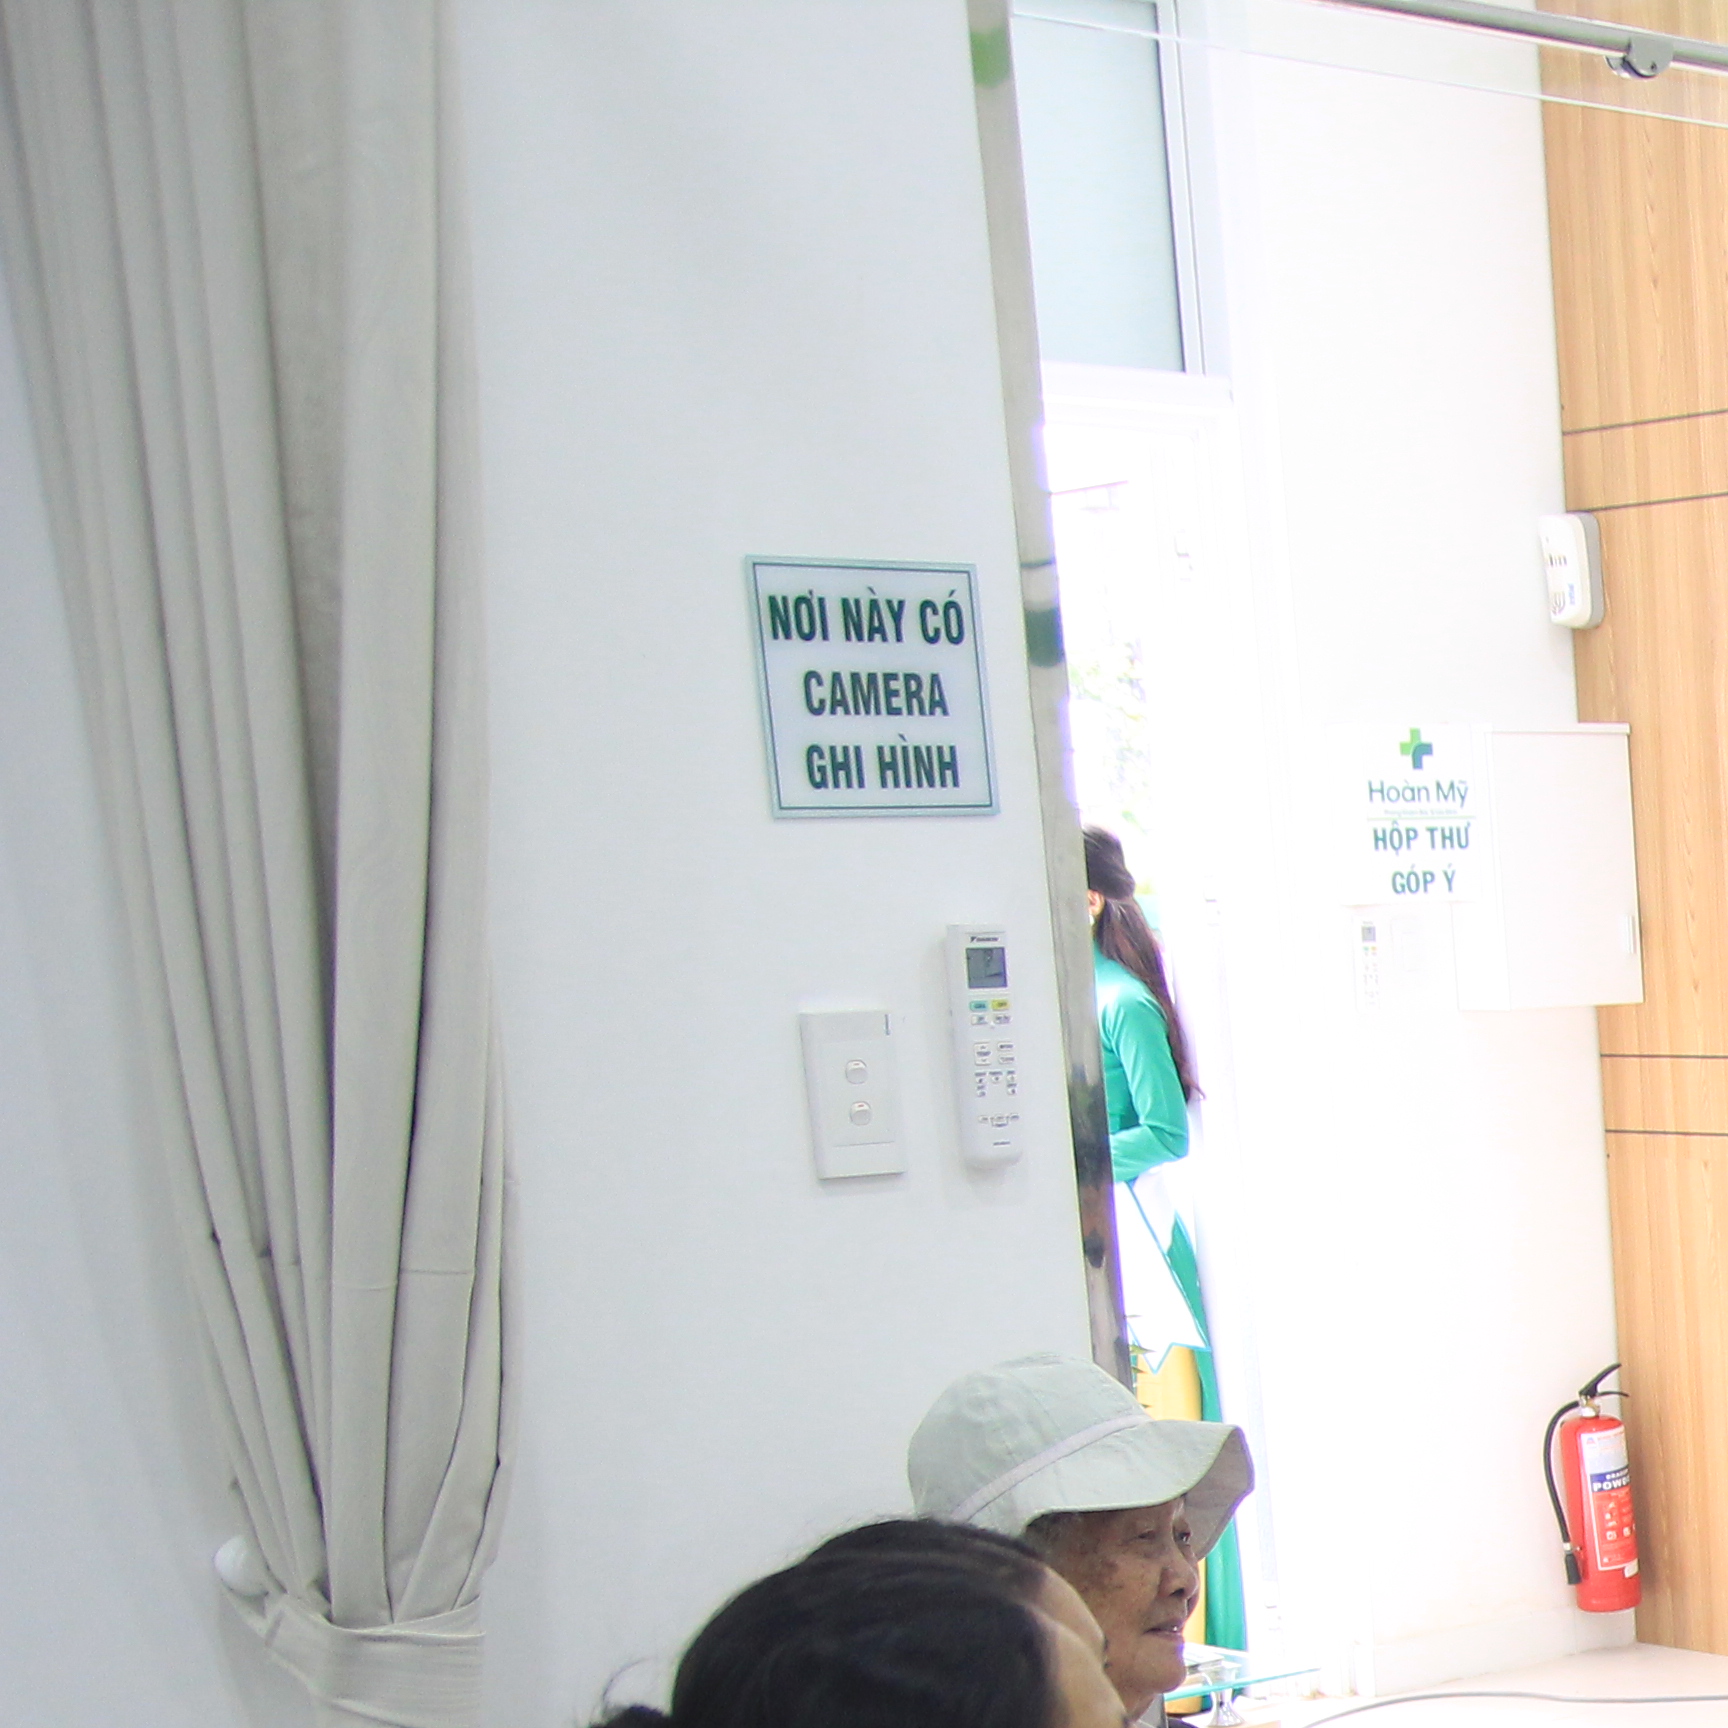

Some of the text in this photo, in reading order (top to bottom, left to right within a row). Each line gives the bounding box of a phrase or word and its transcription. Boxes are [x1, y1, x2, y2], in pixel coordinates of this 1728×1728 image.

[768, 586, 965, 645] NƠI NÀY CÓ
[803, 670, 949, 717] CAMERA
[806, 733, 960, 790] GHI HÌNH
[1367, 779, 1469, 808] Hoàn Mỹ
[1373, 820, 1471, 856] HỘP THƯ
[1391, 862, 1456, 894] GÓP Ý
